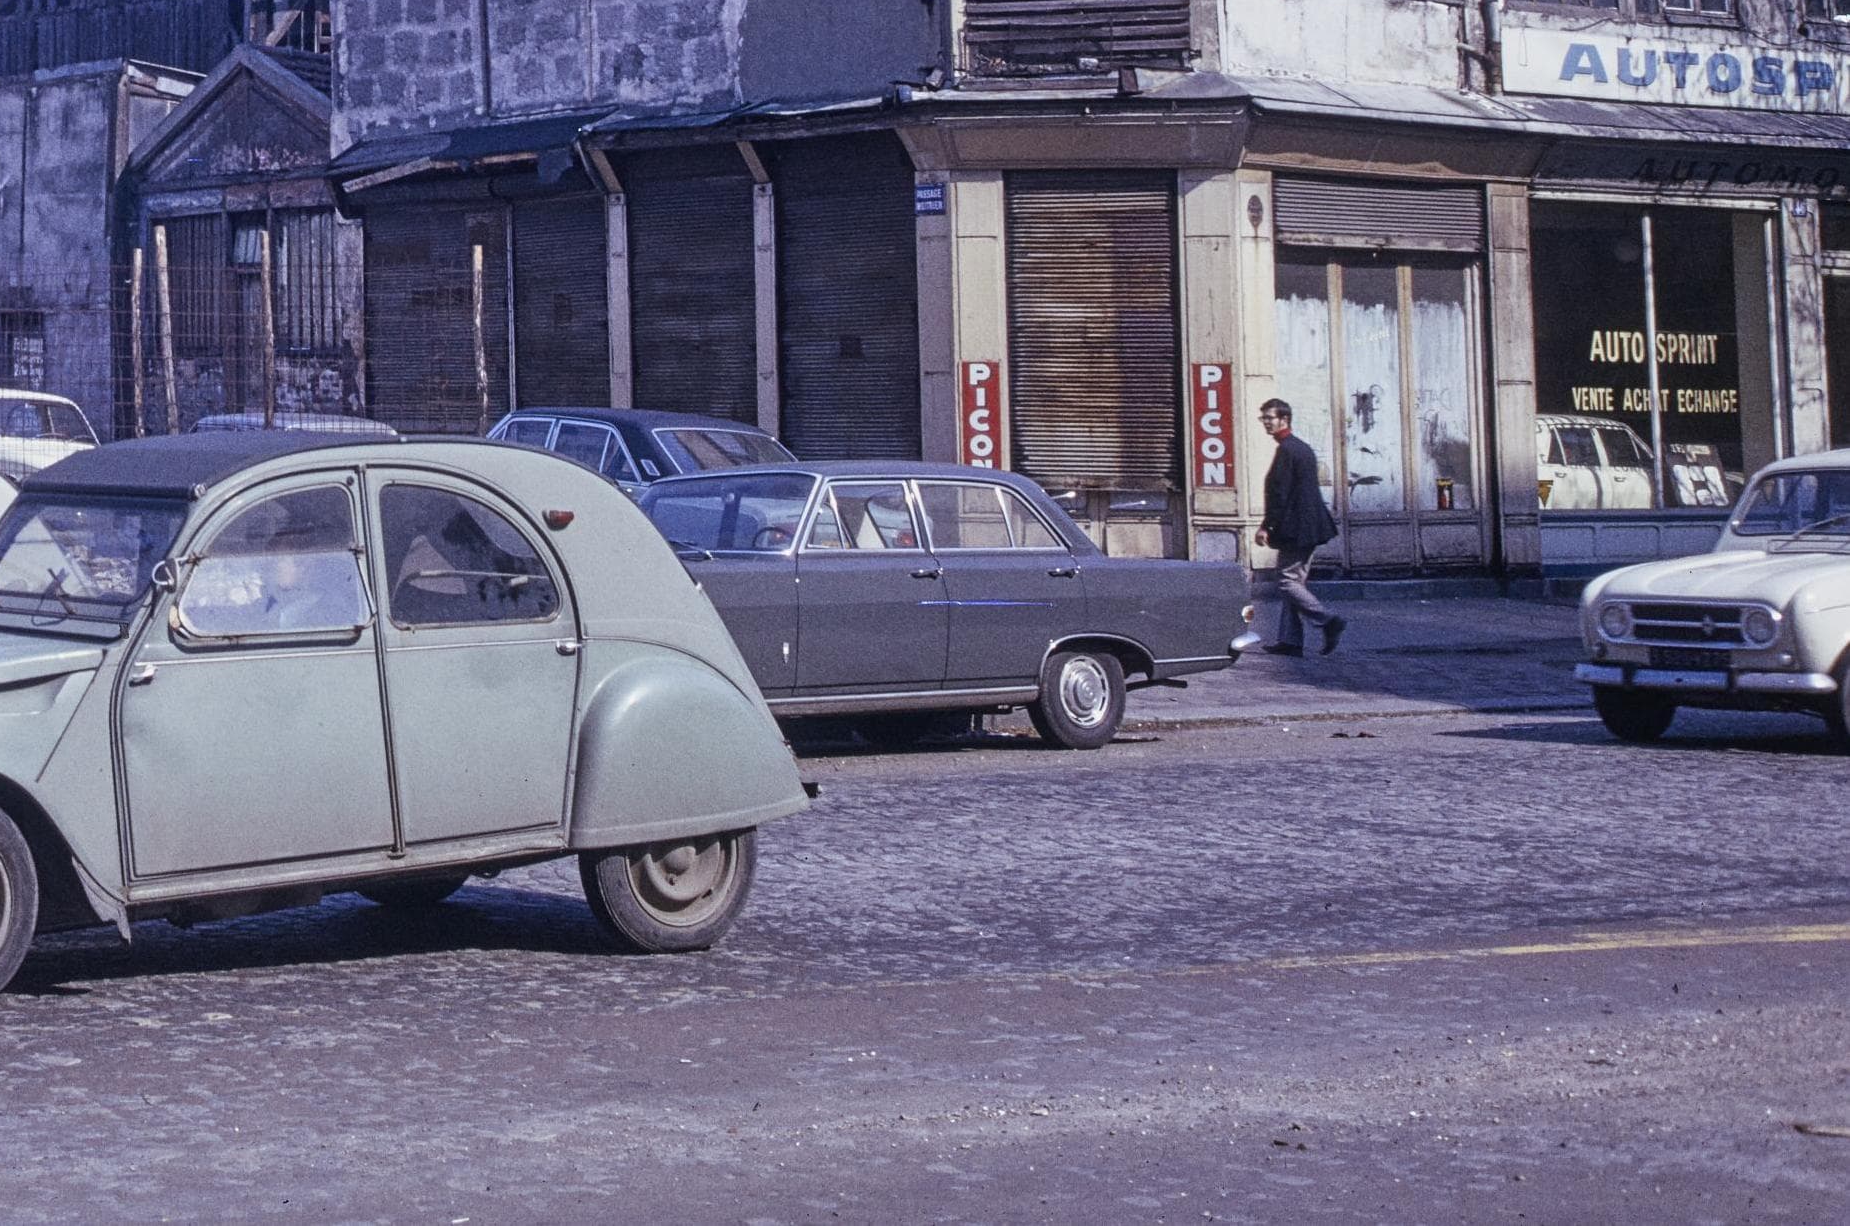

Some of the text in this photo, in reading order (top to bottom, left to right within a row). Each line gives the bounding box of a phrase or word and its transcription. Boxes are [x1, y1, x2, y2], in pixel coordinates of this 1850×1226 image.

[1559, 43, 1850, 96] AUTOSP
[1590, 330, 1718, 364] AUTO SPRINT
[1572, 387, 1614, 411] VENTE
[1677, 389, 1738, 413] ECHANGE
[1200, 365, 1226, 485] PICON
